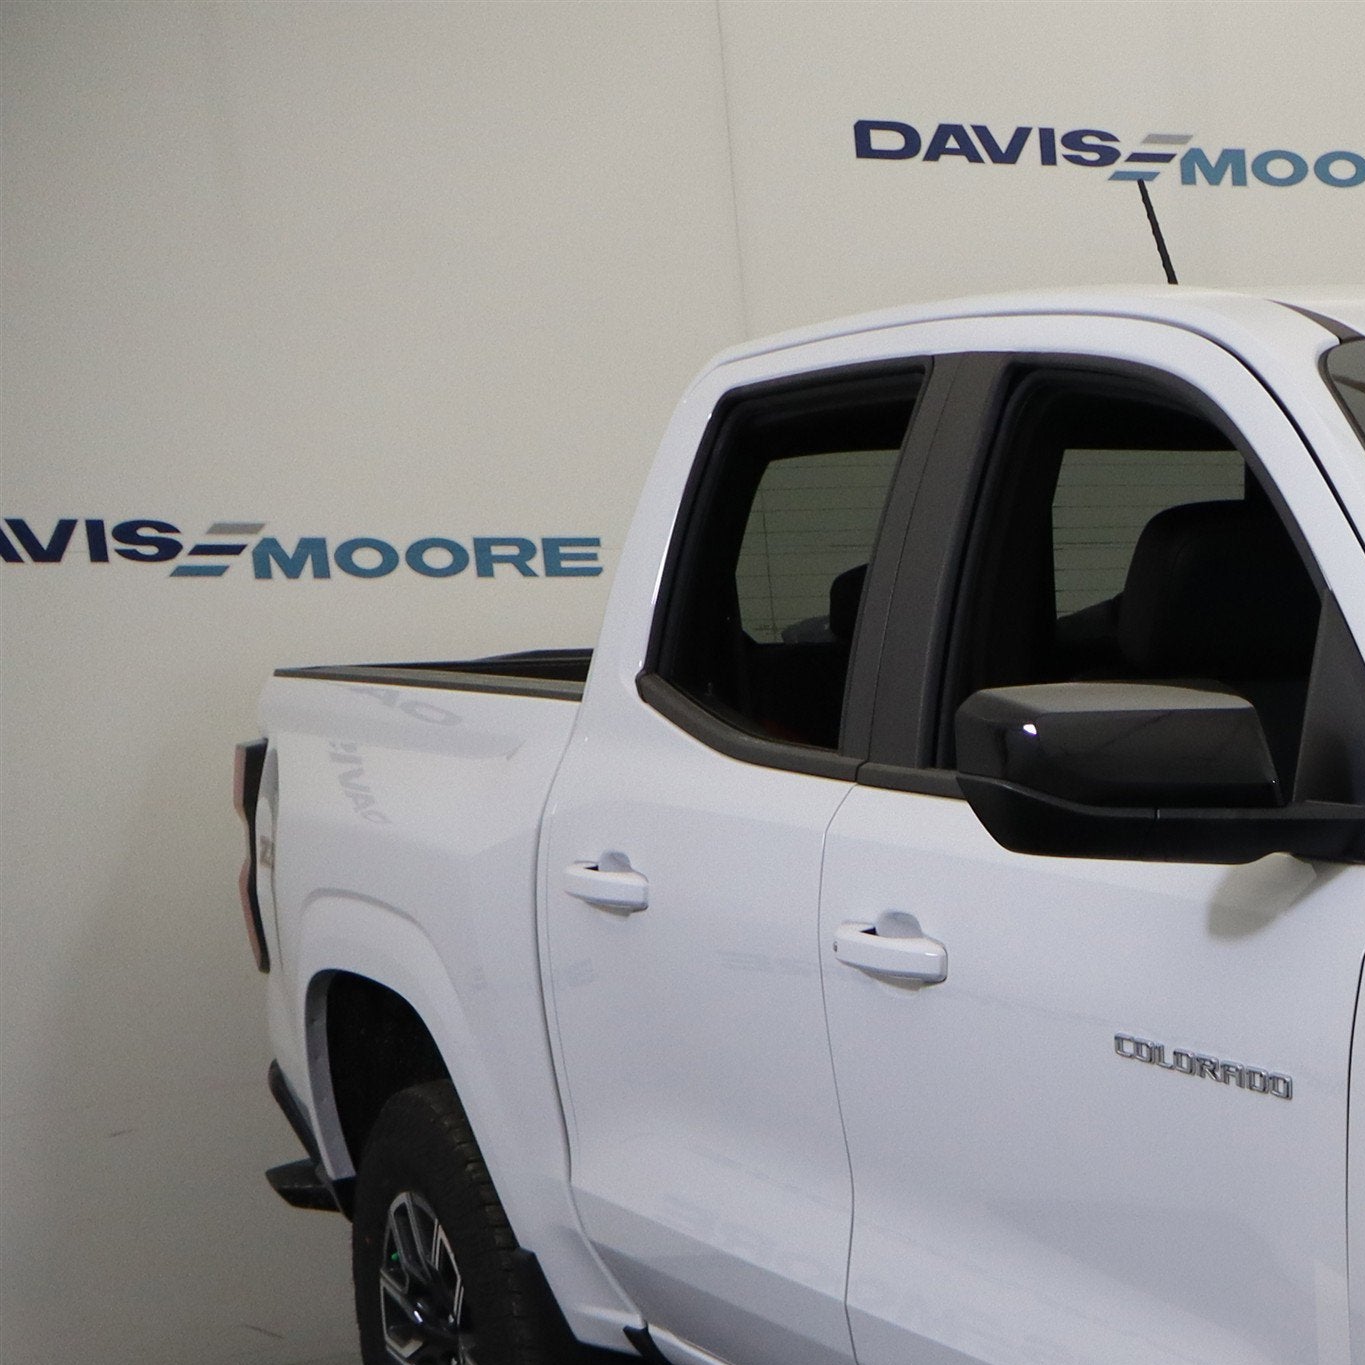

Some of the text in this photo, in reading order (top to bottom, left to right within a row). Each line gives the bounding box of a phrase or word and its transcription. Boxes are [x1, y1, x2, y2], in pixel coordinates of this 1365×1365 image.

[853, 118, 1121, 168] DAVIS
[251, 536, 604, 580] MOORE
[1113, 1032, 1294, 1101] COLORADO
